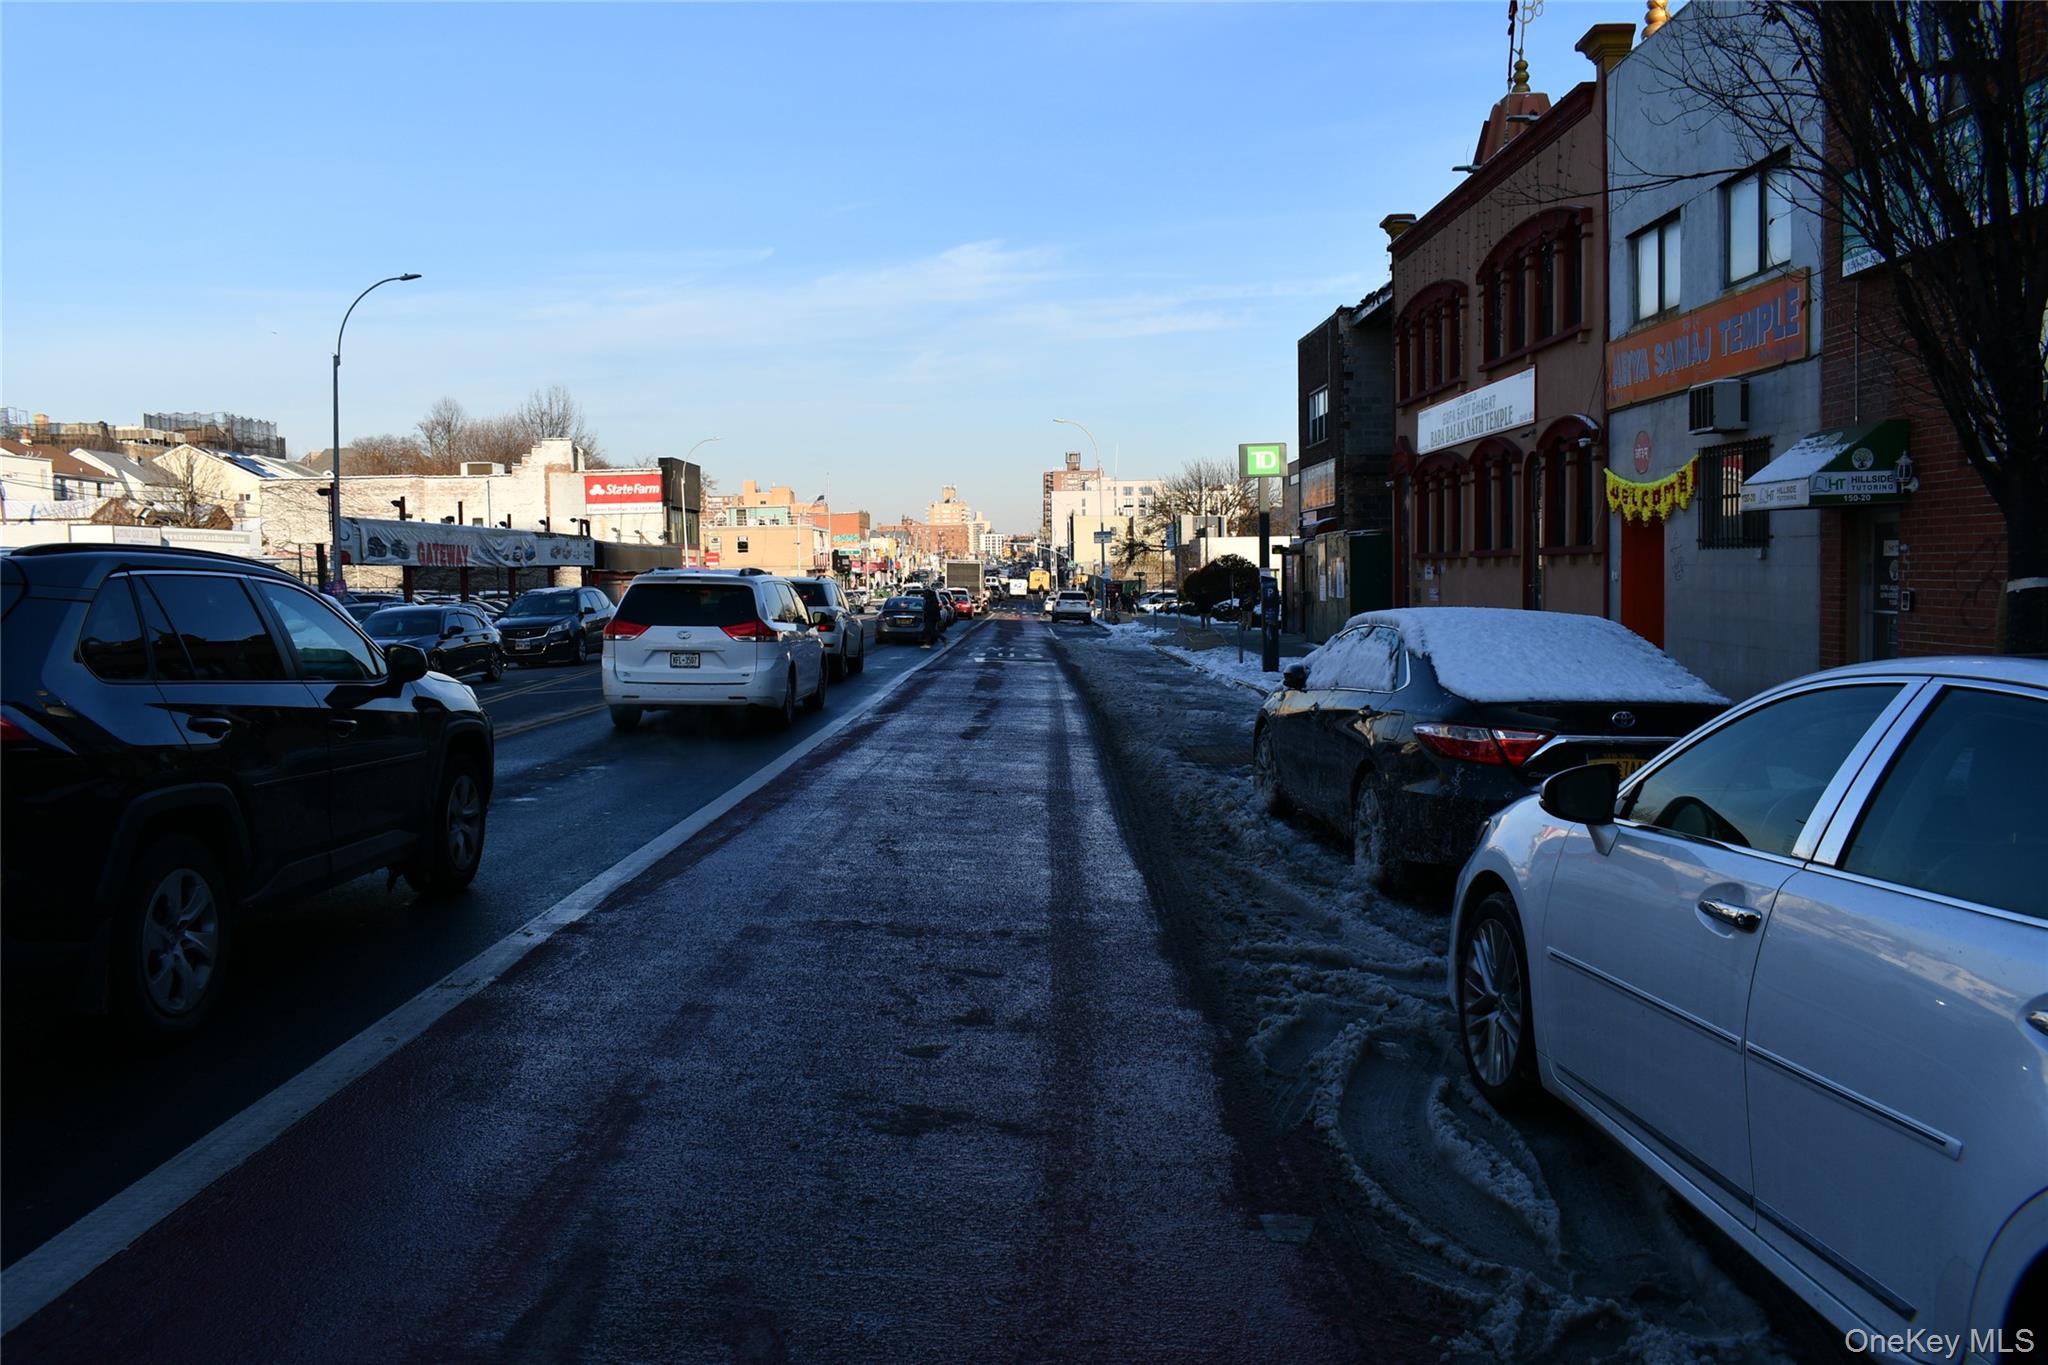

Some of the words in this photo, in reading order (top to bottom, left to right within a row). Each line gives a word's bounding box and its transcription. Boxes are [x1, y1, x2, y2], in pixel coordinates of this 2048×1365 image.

[1718, 287, 1801, 357] TEMPLE
[1466, 413, 1484, 437] NATH
[1485, 405, 1513, 432] TEMPLE
[1250, 451, 1276, 469] TD
[1850, 474, 1894, 483] HILLSIDE
[1843, 494, 1872, 502] 150-20
[416, 542, 469, 567] GATEWAY
[1267, 587, 1274, 597] P
